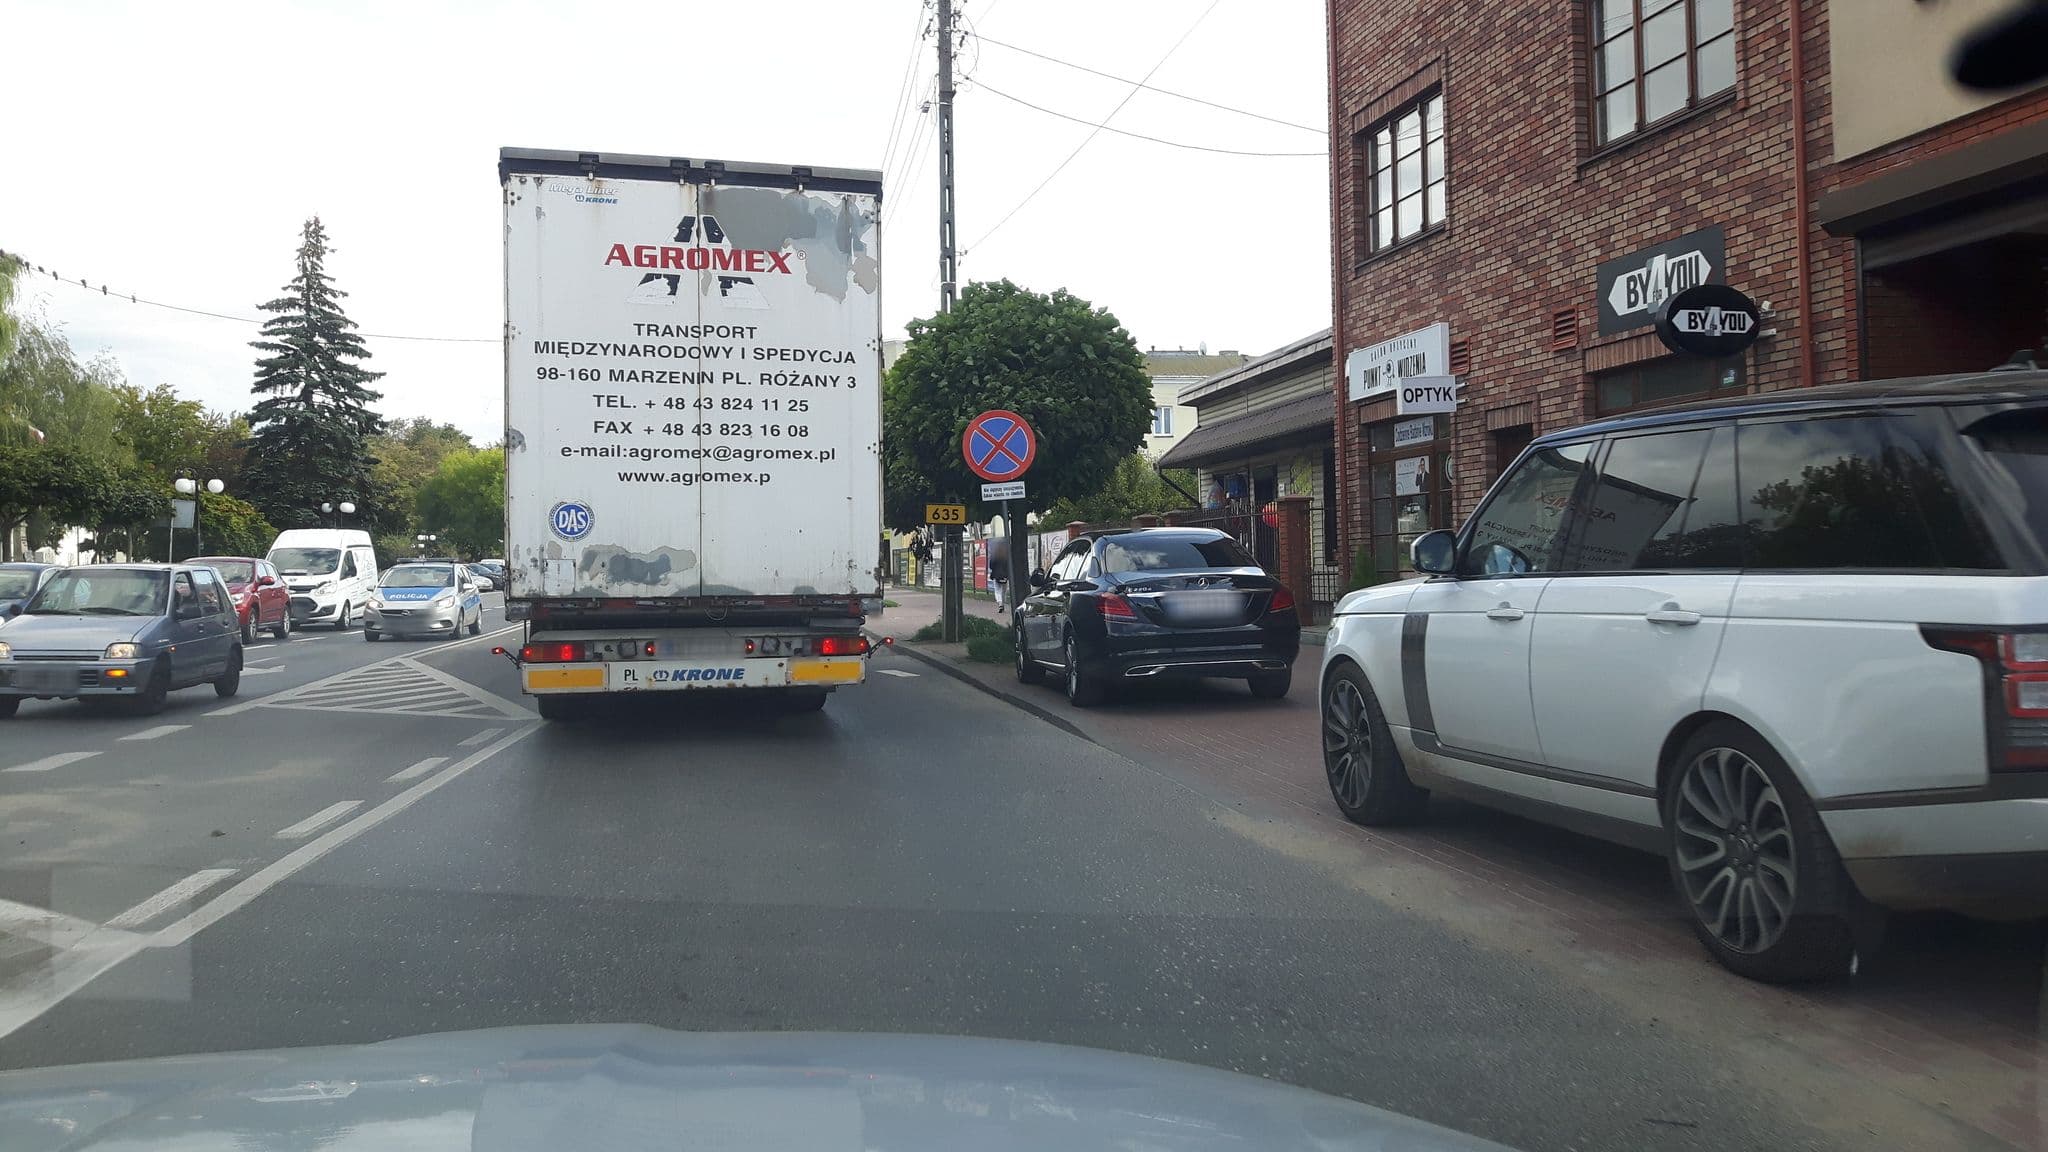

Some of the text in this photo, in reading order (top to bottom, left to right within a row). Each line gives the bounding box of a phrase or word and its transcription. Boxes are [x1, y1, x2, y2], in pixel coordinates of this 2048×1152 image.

[549, 184, 618, 195] Mega Liner
[604, 243, 793, 275] AGROMEX
[633, 324, 757, 339] TRANSPORT
[535, 341, 855, 363] MIĘDZYNARODOWY I SPEDYCJA
[537, 367, 856, 388] 98-160 MARZENIN PL. RÓŻANY 3
[1364, 352, 1426, 390] PUNKT WIDZENIA
[593, 395, 636, 408] TEL.
[664, 398, 685, 409] 48
[692, 397, 713, 409] 43
[721, 398, 753, 410] 824
[762, 399, 777, 411] 11
[788, 400, 808, 412] 25
[1403, 386, 1454, 404] OPTYK
[594, 421, 632, 434] FAX
[662, 423, 683, 435] 48
[692, 423, 712, 435] 43
[720, 424, 752, 437] 823
[761, 425, 780, 436] 16
[788, 425, 808, 437] 08
[561, 445, 834, 463] e-mail:agromex@agromex.pl
[559, 509, 587, 532] DAS
[932, 508, 959, 521] 635
[624, 669, 638, 681] PL
[671, 668, 745, 681] KRONE
